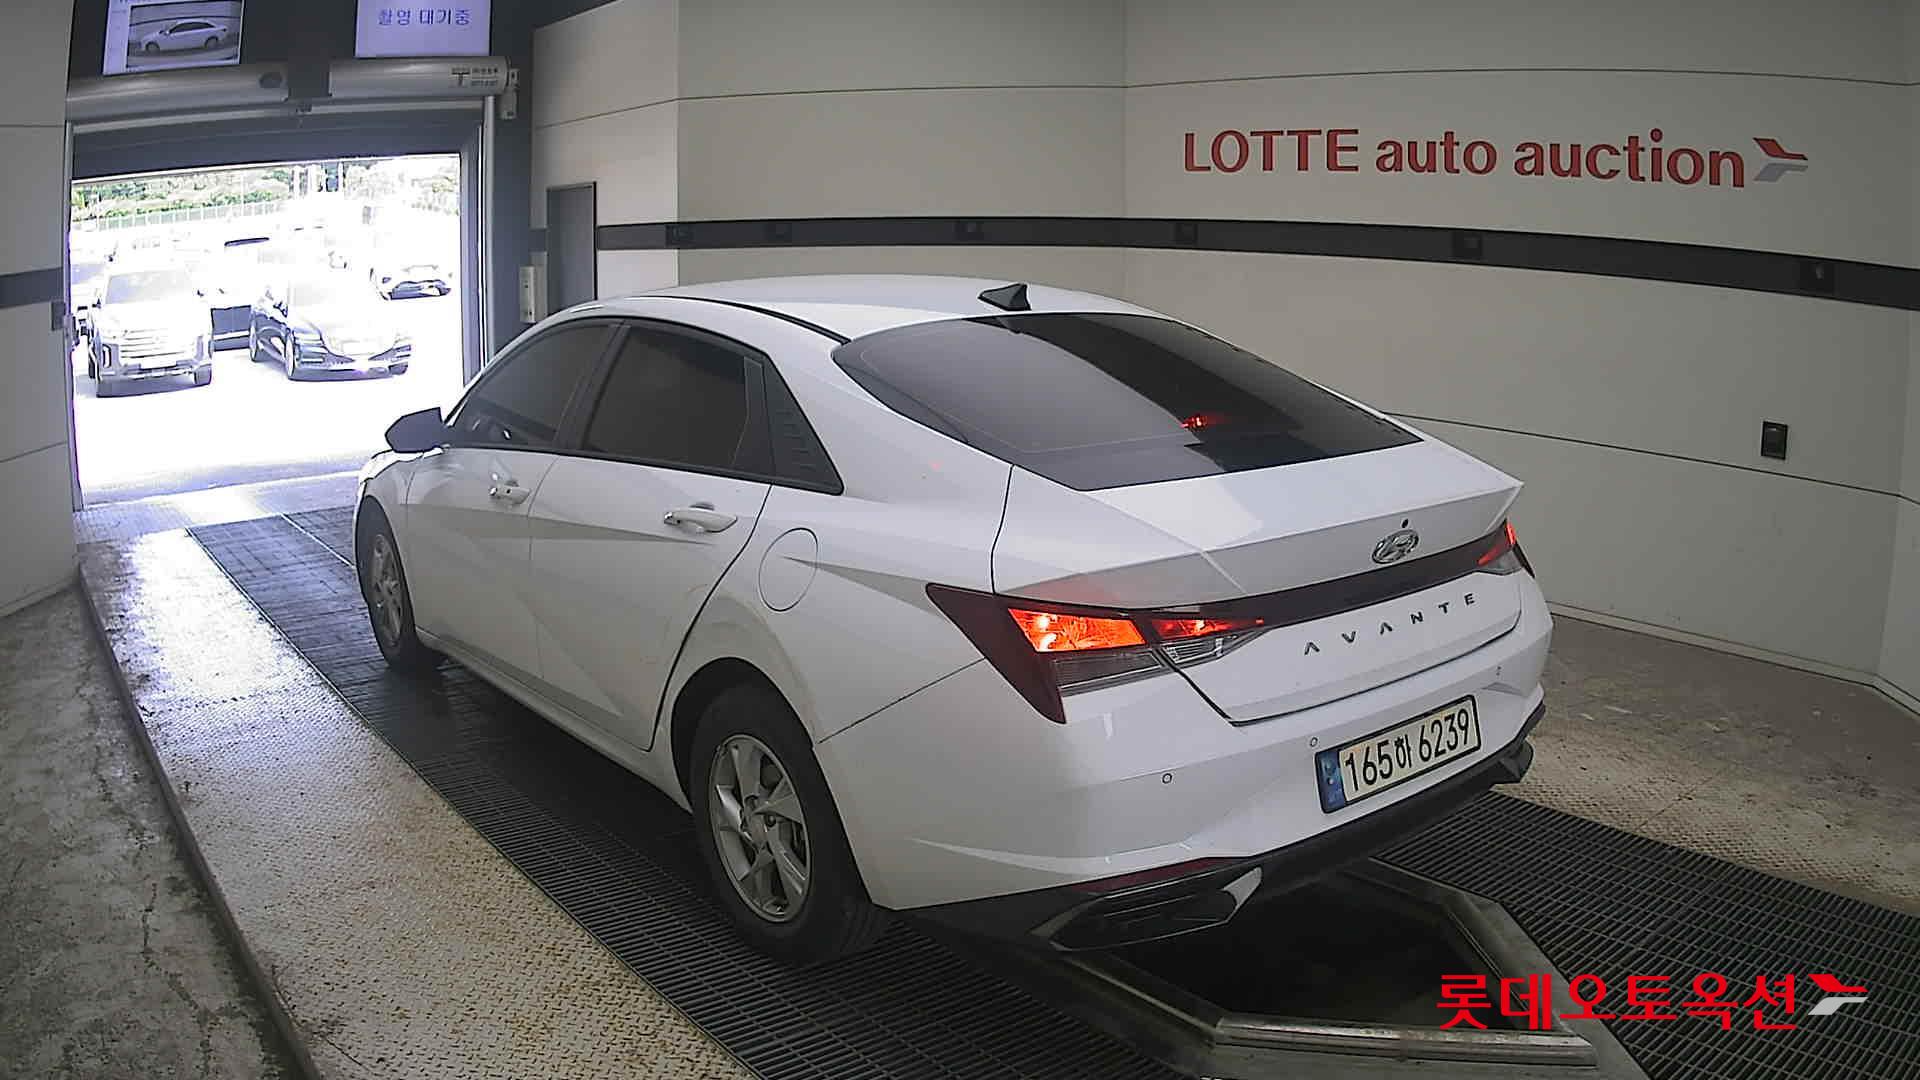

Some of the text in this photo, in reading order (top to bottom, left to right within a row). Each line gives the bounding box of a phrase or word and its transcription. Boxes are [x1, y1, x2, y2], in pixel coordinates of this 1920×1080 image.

[419, 8, 473, 27] 대기중
[1184, 128, 1746, 189] LOTTE auto auction
[1303, 592, 1476, 656] AVANTE
[1343, 707, 1471, 793] 165하 6239
